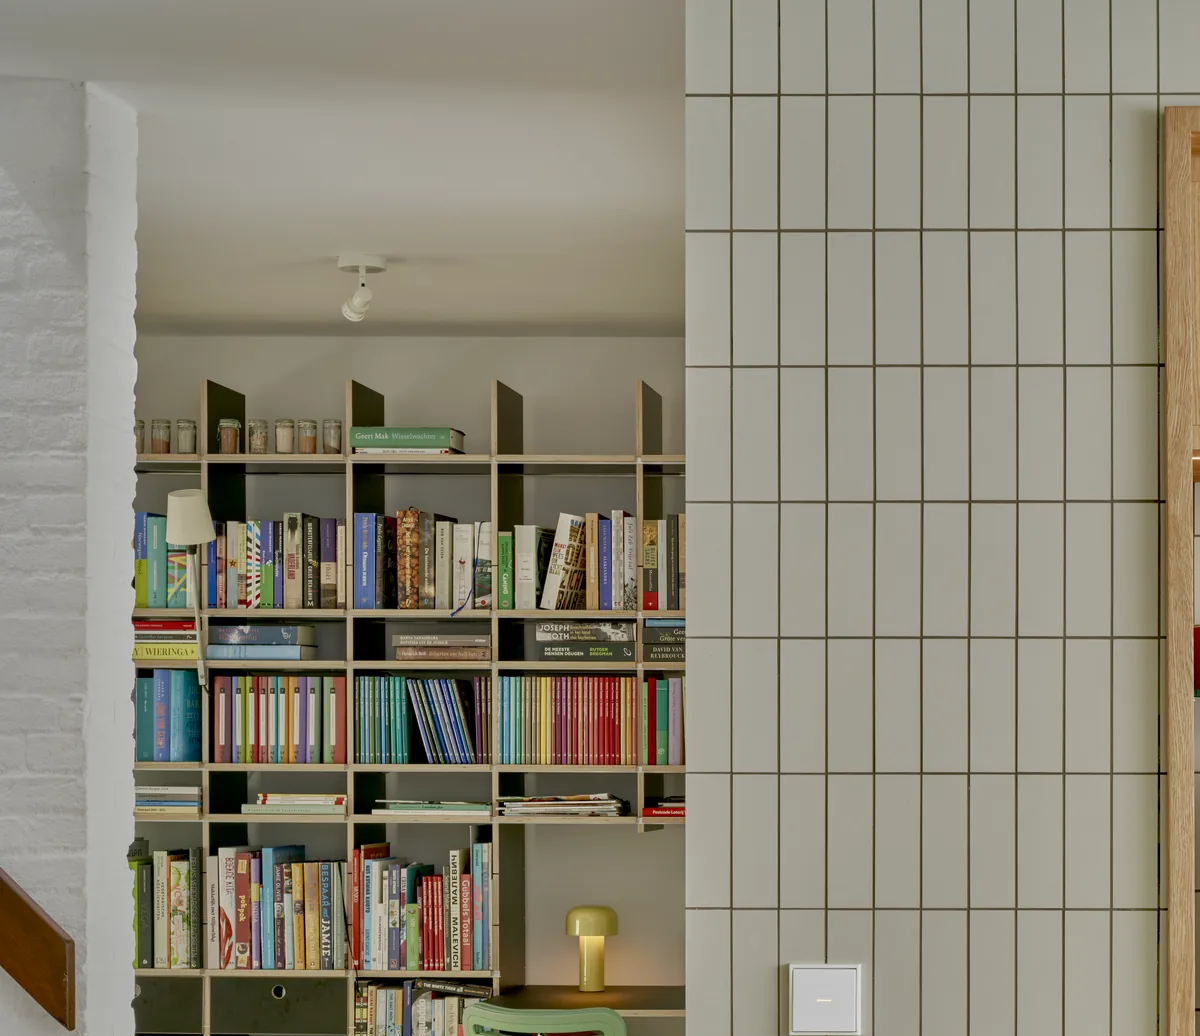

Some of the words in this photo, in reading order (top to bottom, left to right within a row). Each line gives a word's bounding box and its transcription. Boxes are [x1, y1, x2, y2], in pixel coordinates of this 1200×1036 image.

[287, 553, 295, 580] VADERLAND
[145, 648, 189, 656] WIERINGA
[321, 864, 329, 907] BESPAAR
[462, 880, 470, 916] Gubbels
[322, 918, 330, 956] JAMIE
[462, 919, 470, 946] Totaal
